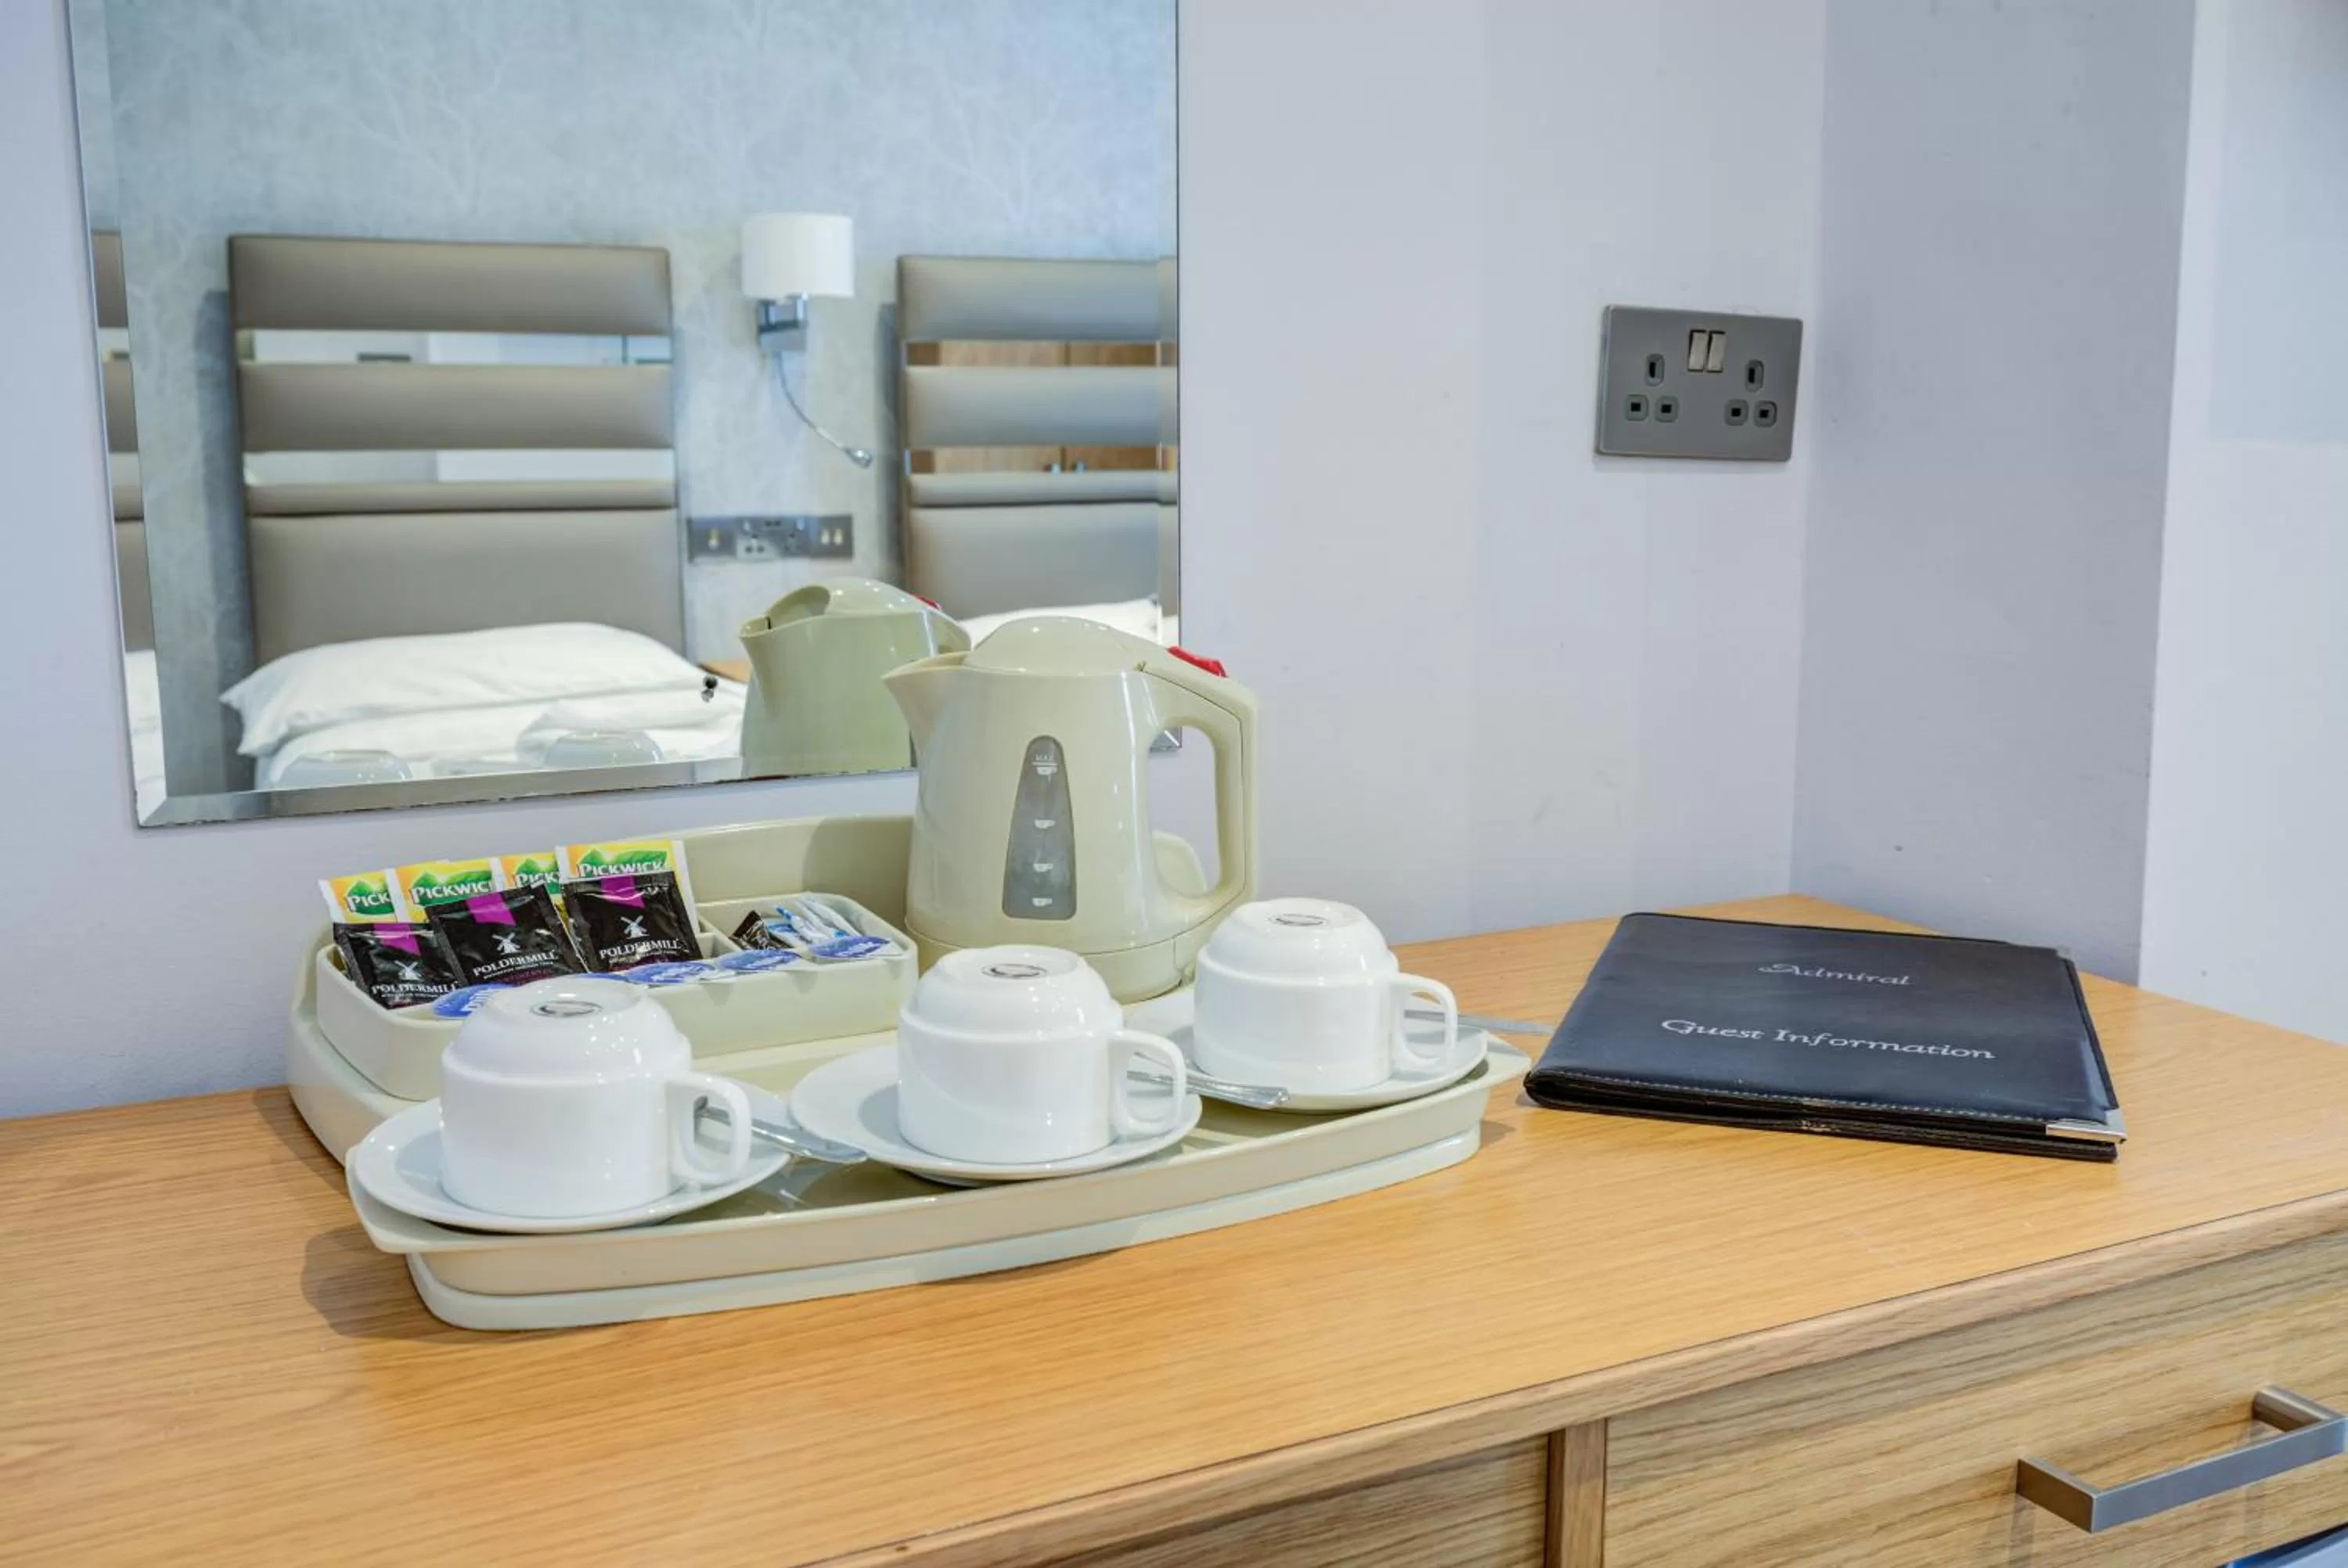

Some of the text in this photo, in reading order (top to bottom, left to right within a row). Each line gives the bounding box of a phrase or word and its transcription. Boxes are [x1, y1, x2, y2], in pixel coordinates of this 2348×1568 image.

[577, 860, 666, 877] PICKWICK
[599, 939, 681, 959] POLDERMILL
[472, 949, 559, 977] POLDERMILL
[1757, 963, 1910, 985] Admiral
[1661, 1020, 1996, 1059] Guest Information
